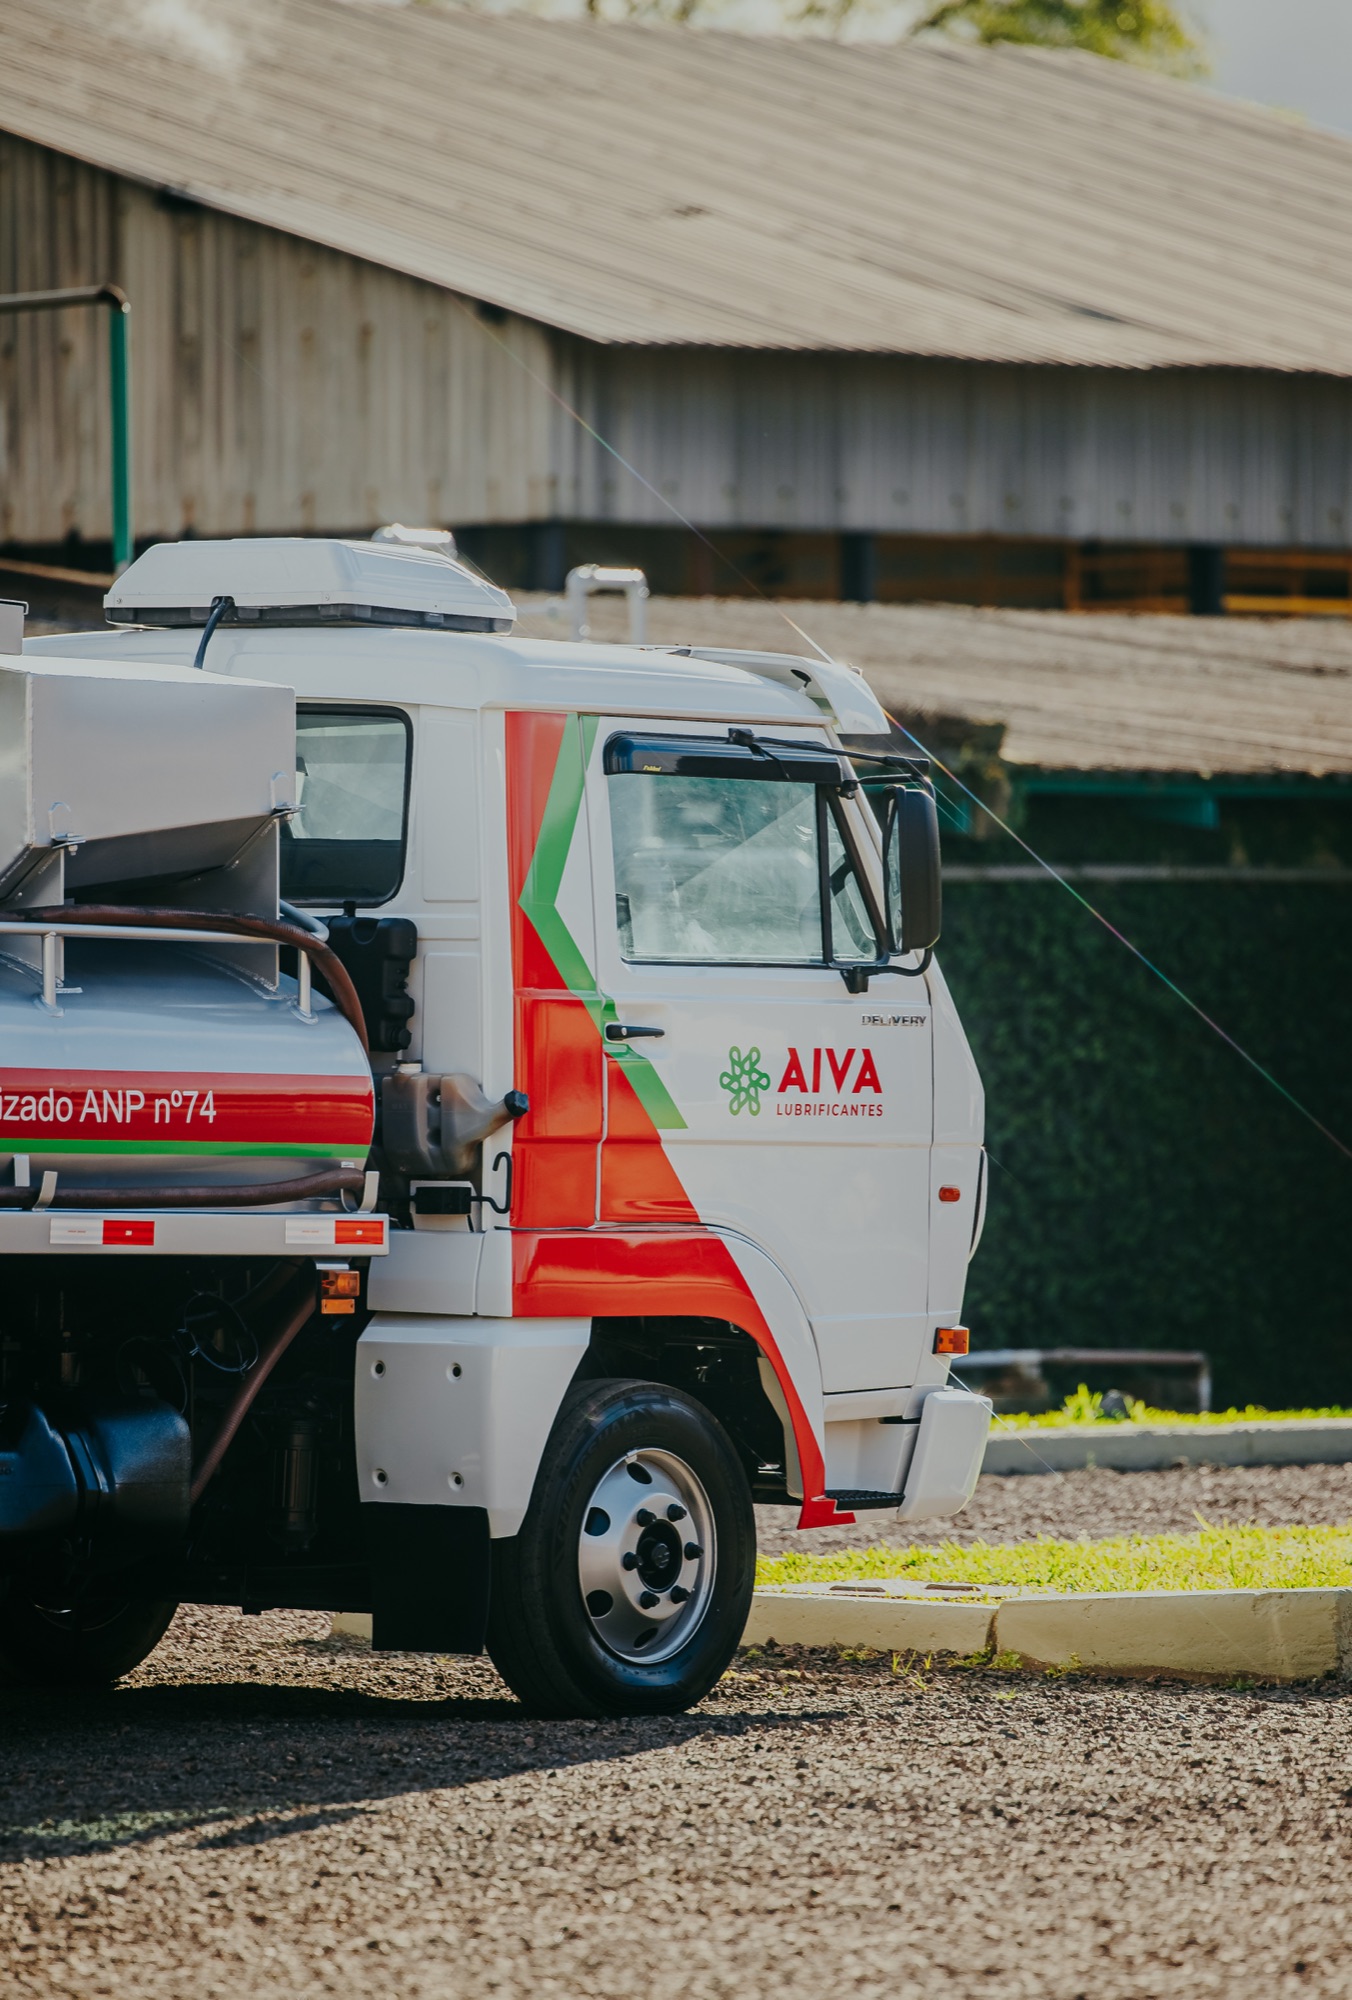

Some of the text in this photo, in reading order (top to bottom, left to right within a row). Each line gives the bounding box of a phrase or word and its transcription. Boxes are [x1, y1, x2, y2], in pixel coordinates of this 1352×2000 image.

[861, 1014, 927, 1027] DELIVERY
[777, 1047, 883, 1094] AIVA
[79, 1089, 145, 1123] ANP
[154, 1089, 217, 1124] nº74
[776, 1103, 883, 1117] LUBRIFICANTES
